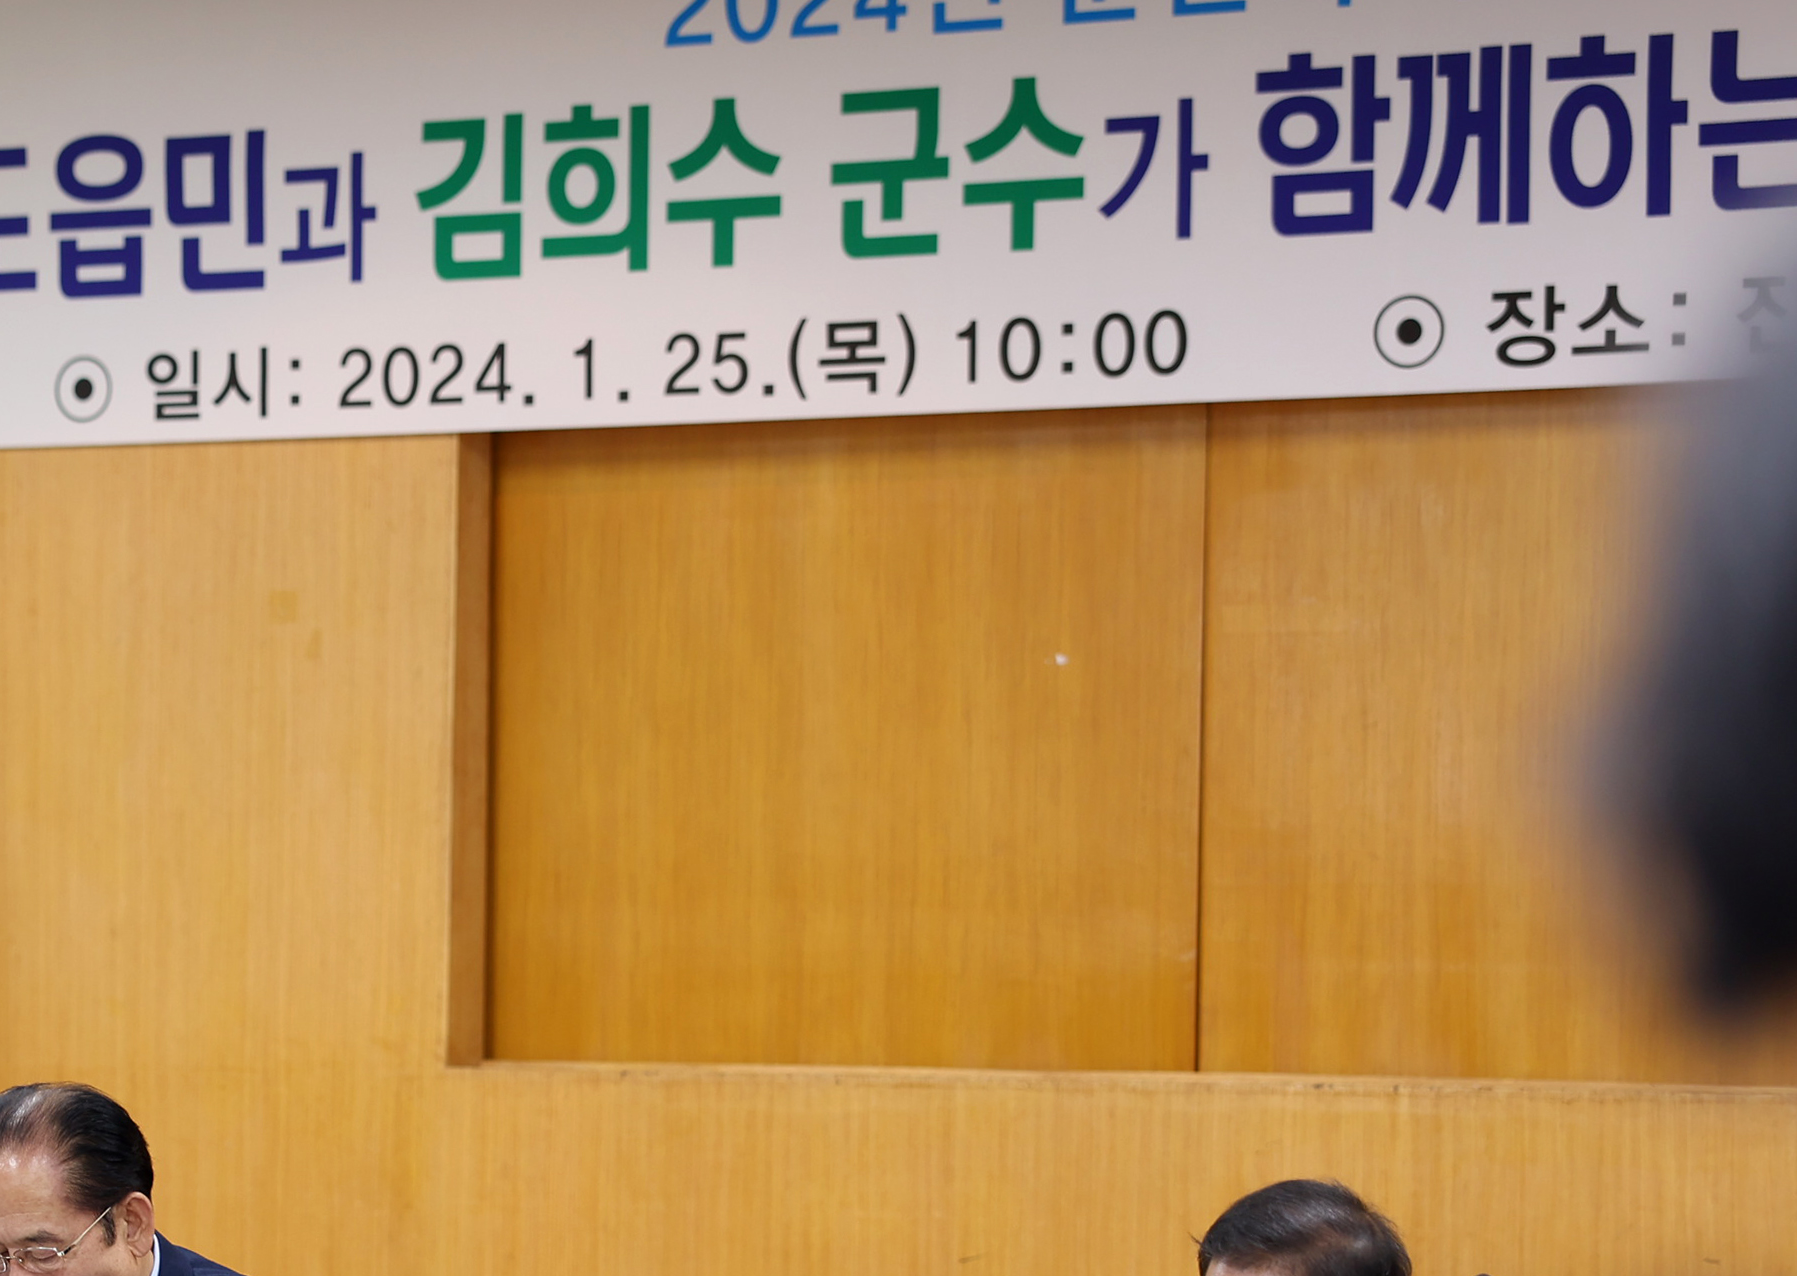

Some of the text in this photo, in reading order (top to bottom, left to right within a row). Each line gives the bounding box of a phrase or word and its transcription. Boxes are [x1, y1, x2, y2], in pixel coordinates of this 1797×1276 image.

[415, 97, 782, 281] 김희수
[830, 76, 1209, 259] 군수가
[1255, 29, 1797, 237] 함께하는
[147, 309, 1189, 420] 일시: 2024. 1. 25.(목) 10:00
[1486, 284, 1688, 368] 장소:
